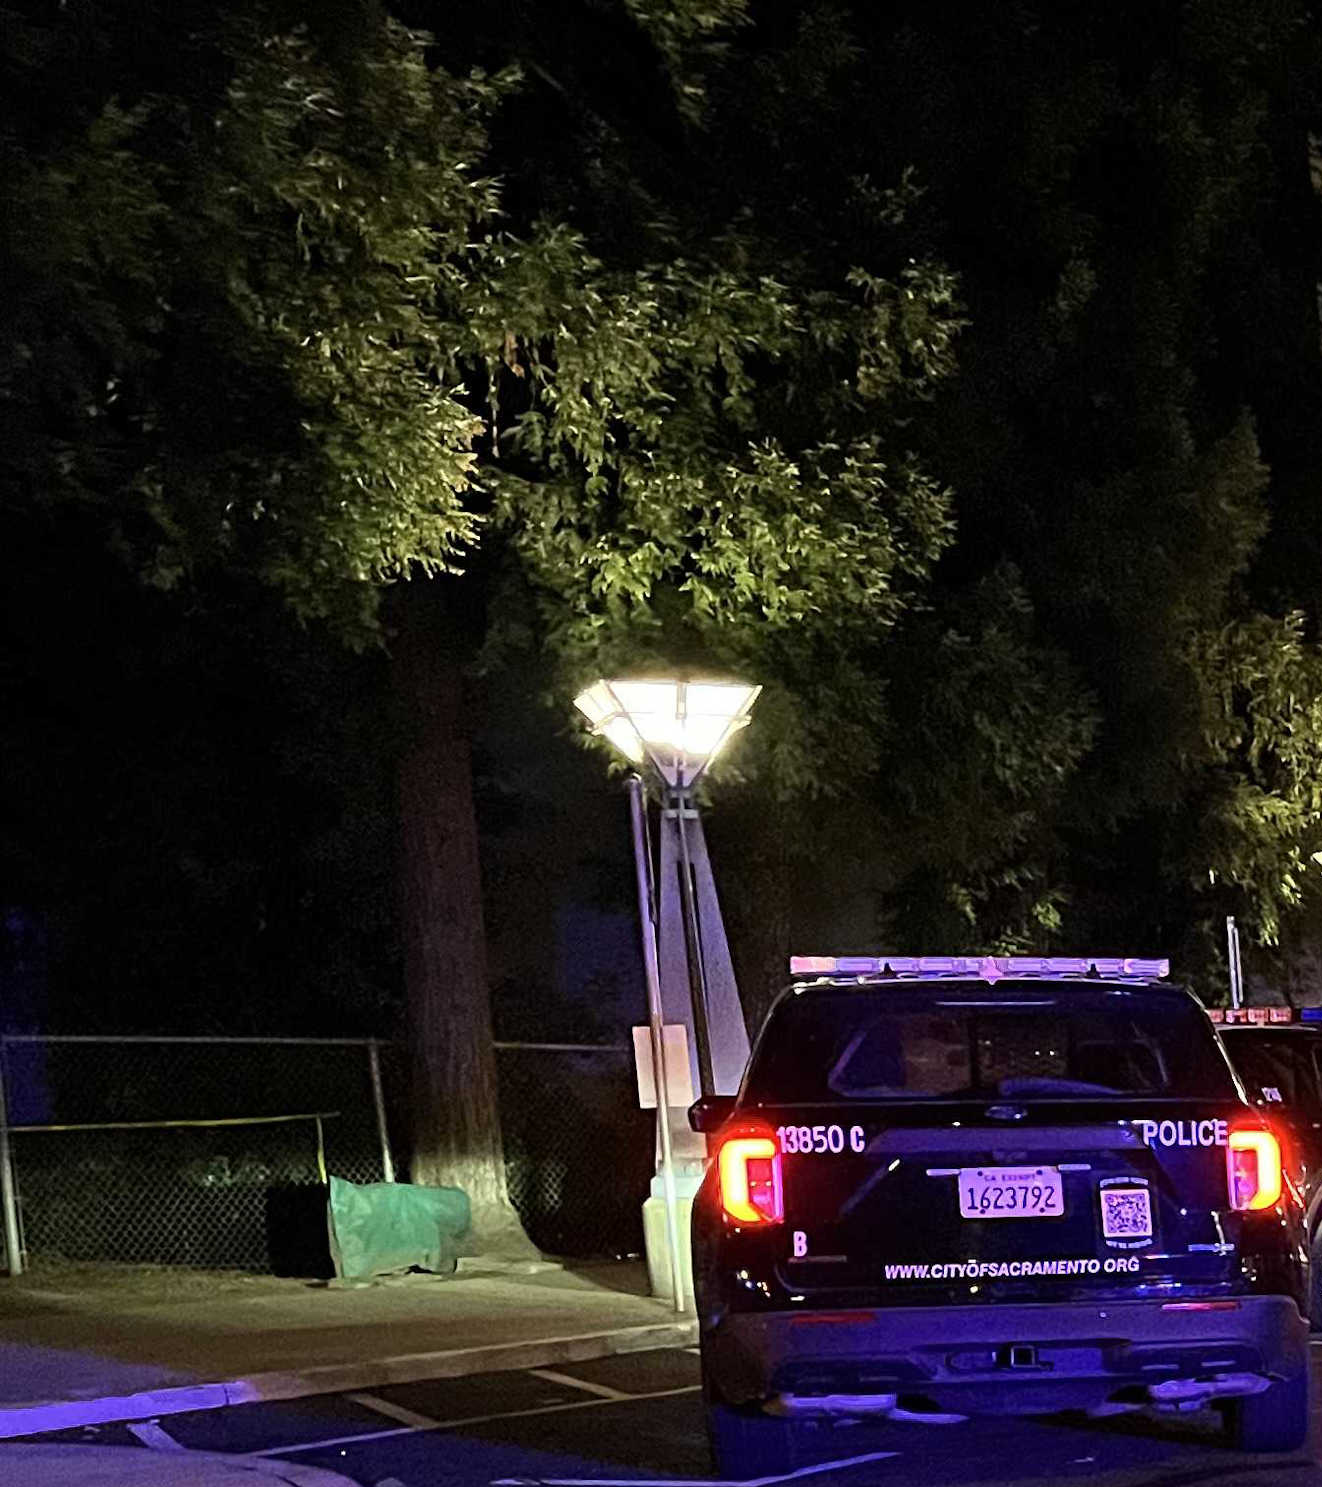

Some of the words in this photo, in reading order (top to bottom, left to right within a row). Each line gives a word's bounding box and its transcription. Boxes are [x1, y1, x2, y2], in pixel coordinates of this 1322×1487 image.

[776, 1125, 844, 1154] 13850
[850, 1125, 865, 1153] C
[1143, 1119, 1228, 1147] POLICE
[967, 1185, 1057, 1211] 1623792
[793, 1231, 808, 1257] B
[884, 1256, 1140, 1280] WWW.CITYOFSACRAMENTOORG
